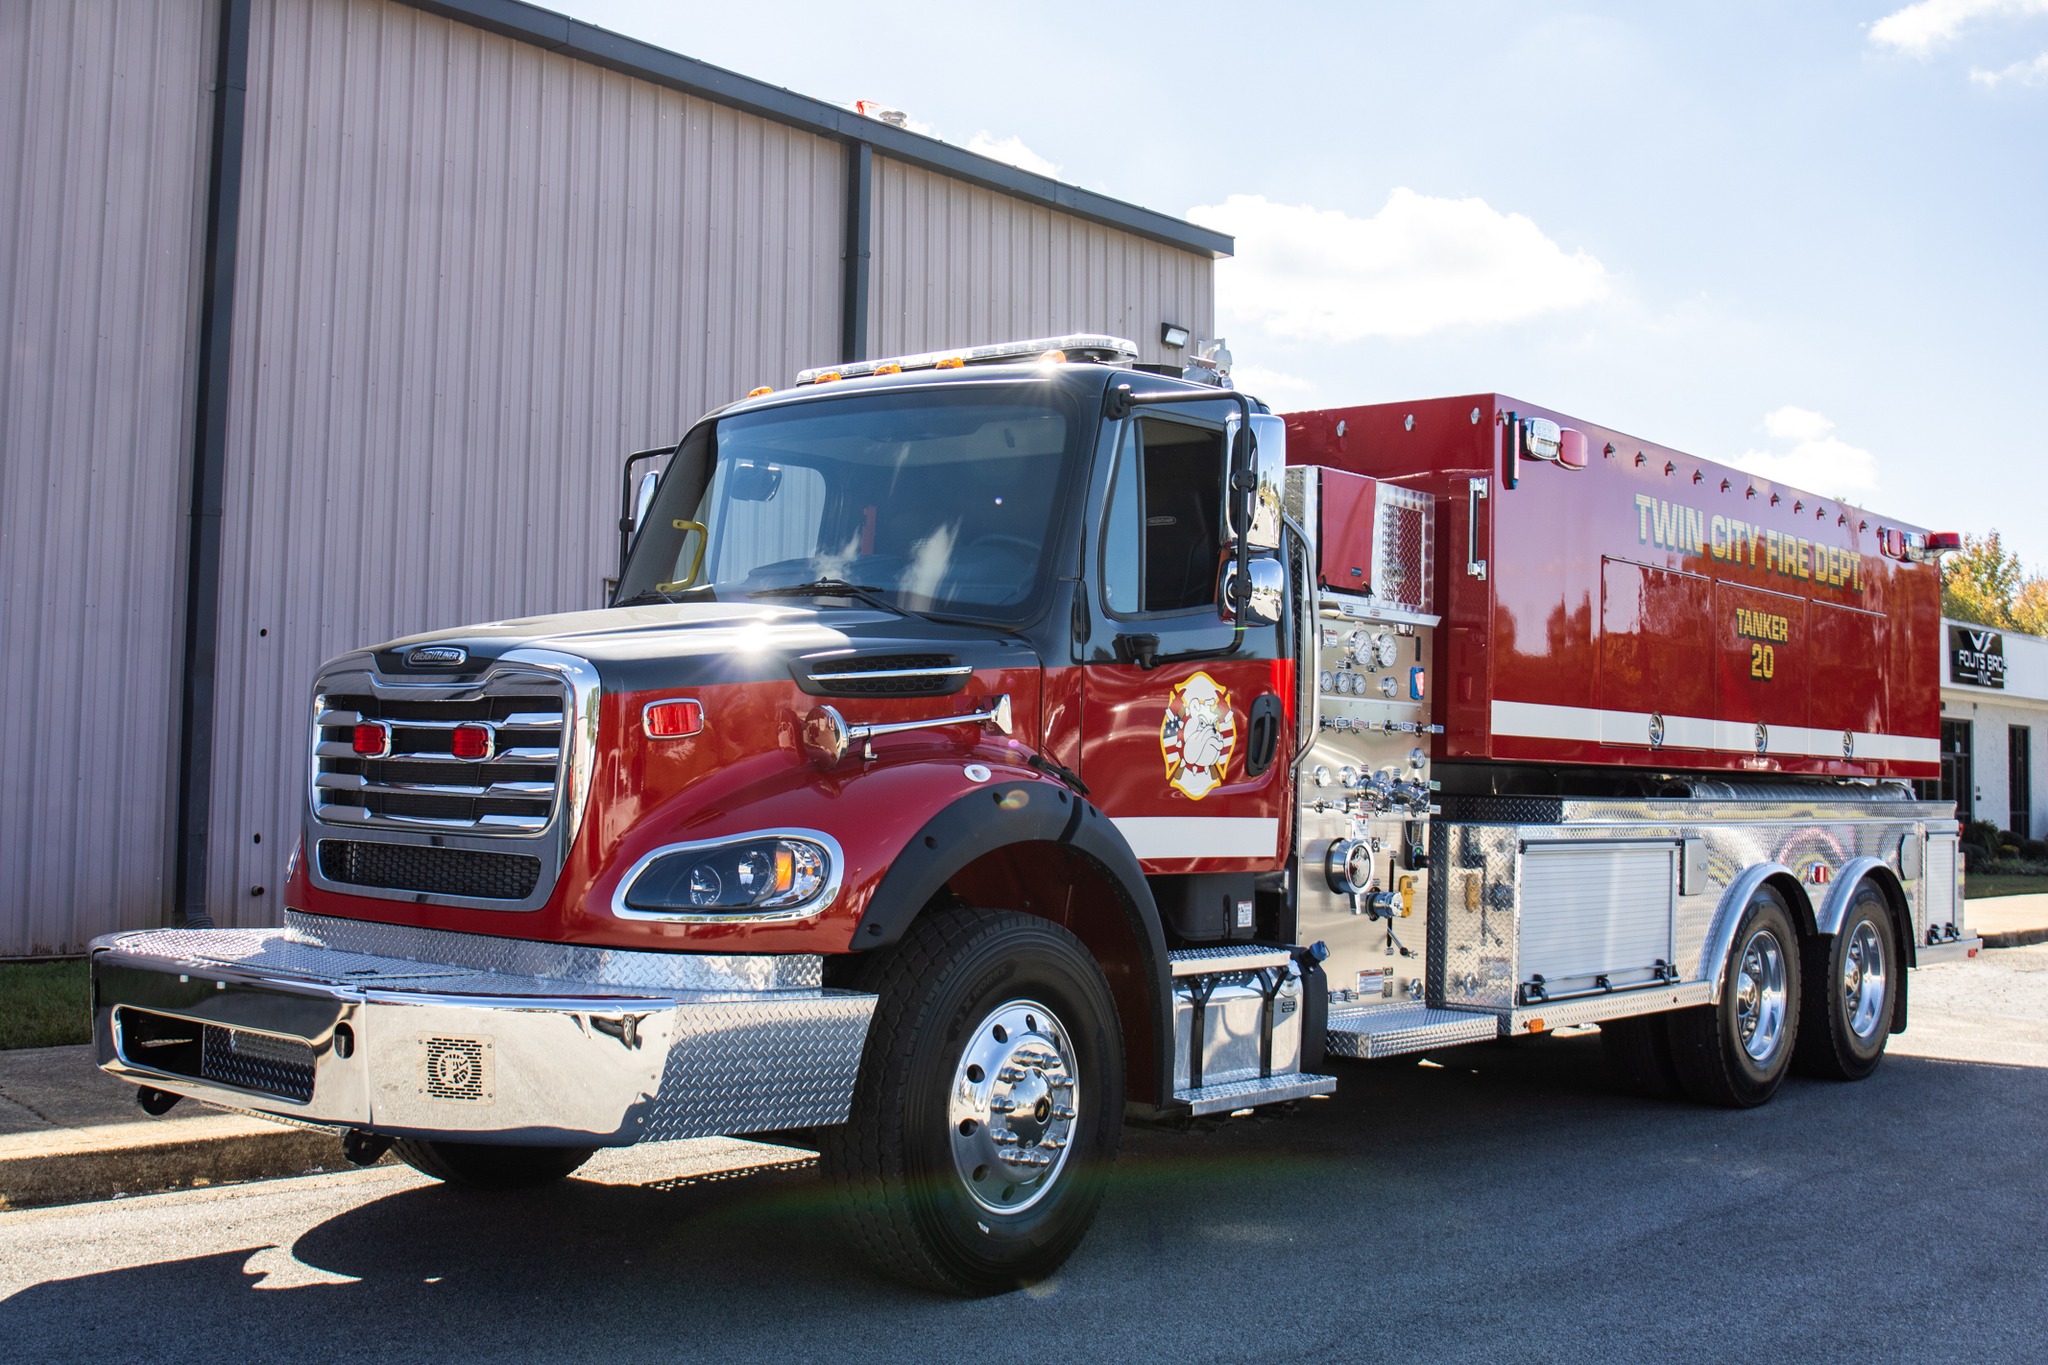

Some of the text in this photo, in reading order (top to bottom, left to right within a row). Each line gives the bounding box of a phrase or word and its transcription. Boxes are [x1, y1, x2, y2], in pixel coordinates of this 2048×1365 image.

[1634, 493, 1864, 594] TWIN CITY FIRE DEPT.
[1736, 607, 1788, 645] TANKER
[1751, 643, 1774, 682] 20
[1959, 649, 1986, 670] FOUTS
[1977, 669, 1992, 686] INC
